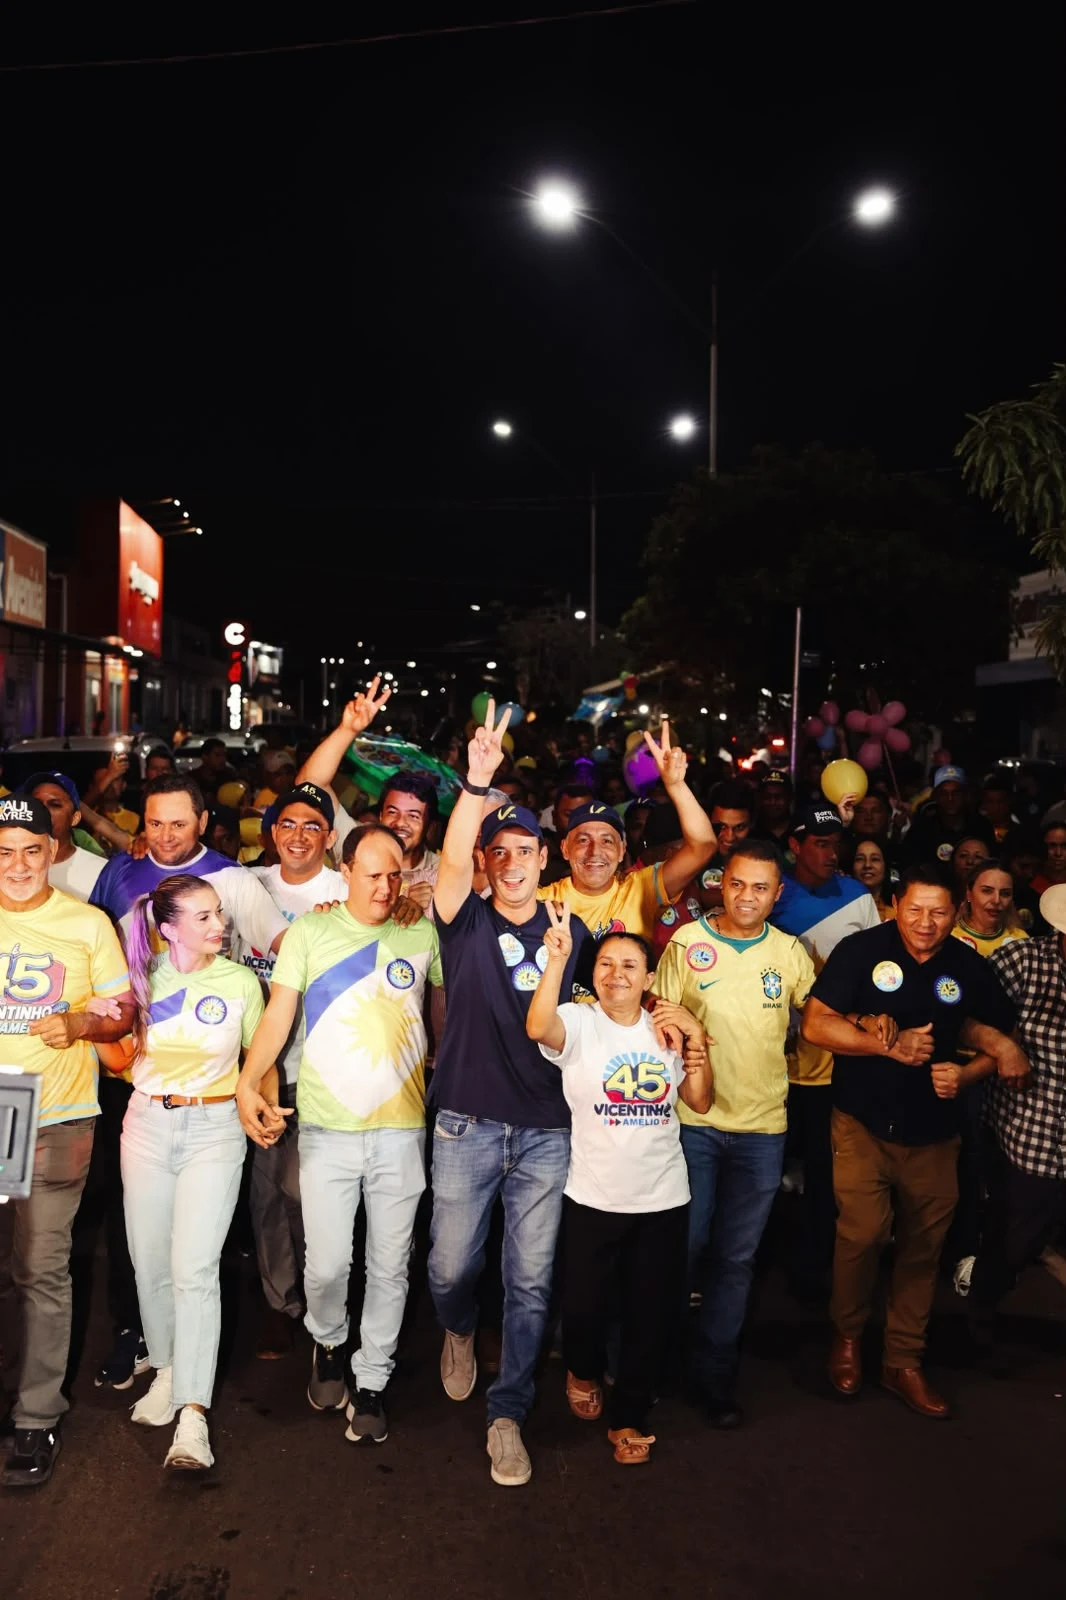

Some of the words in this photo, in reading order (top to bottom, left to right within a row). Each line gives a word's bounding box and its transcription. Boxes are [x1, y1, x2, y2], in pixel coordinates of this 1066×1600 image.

[301, 784, 316, 794] 45
[242, 955, 276, 971] VICEN
[0, 1021, 30, 1034] AME
[604, 1062, 667, 1103] 45
